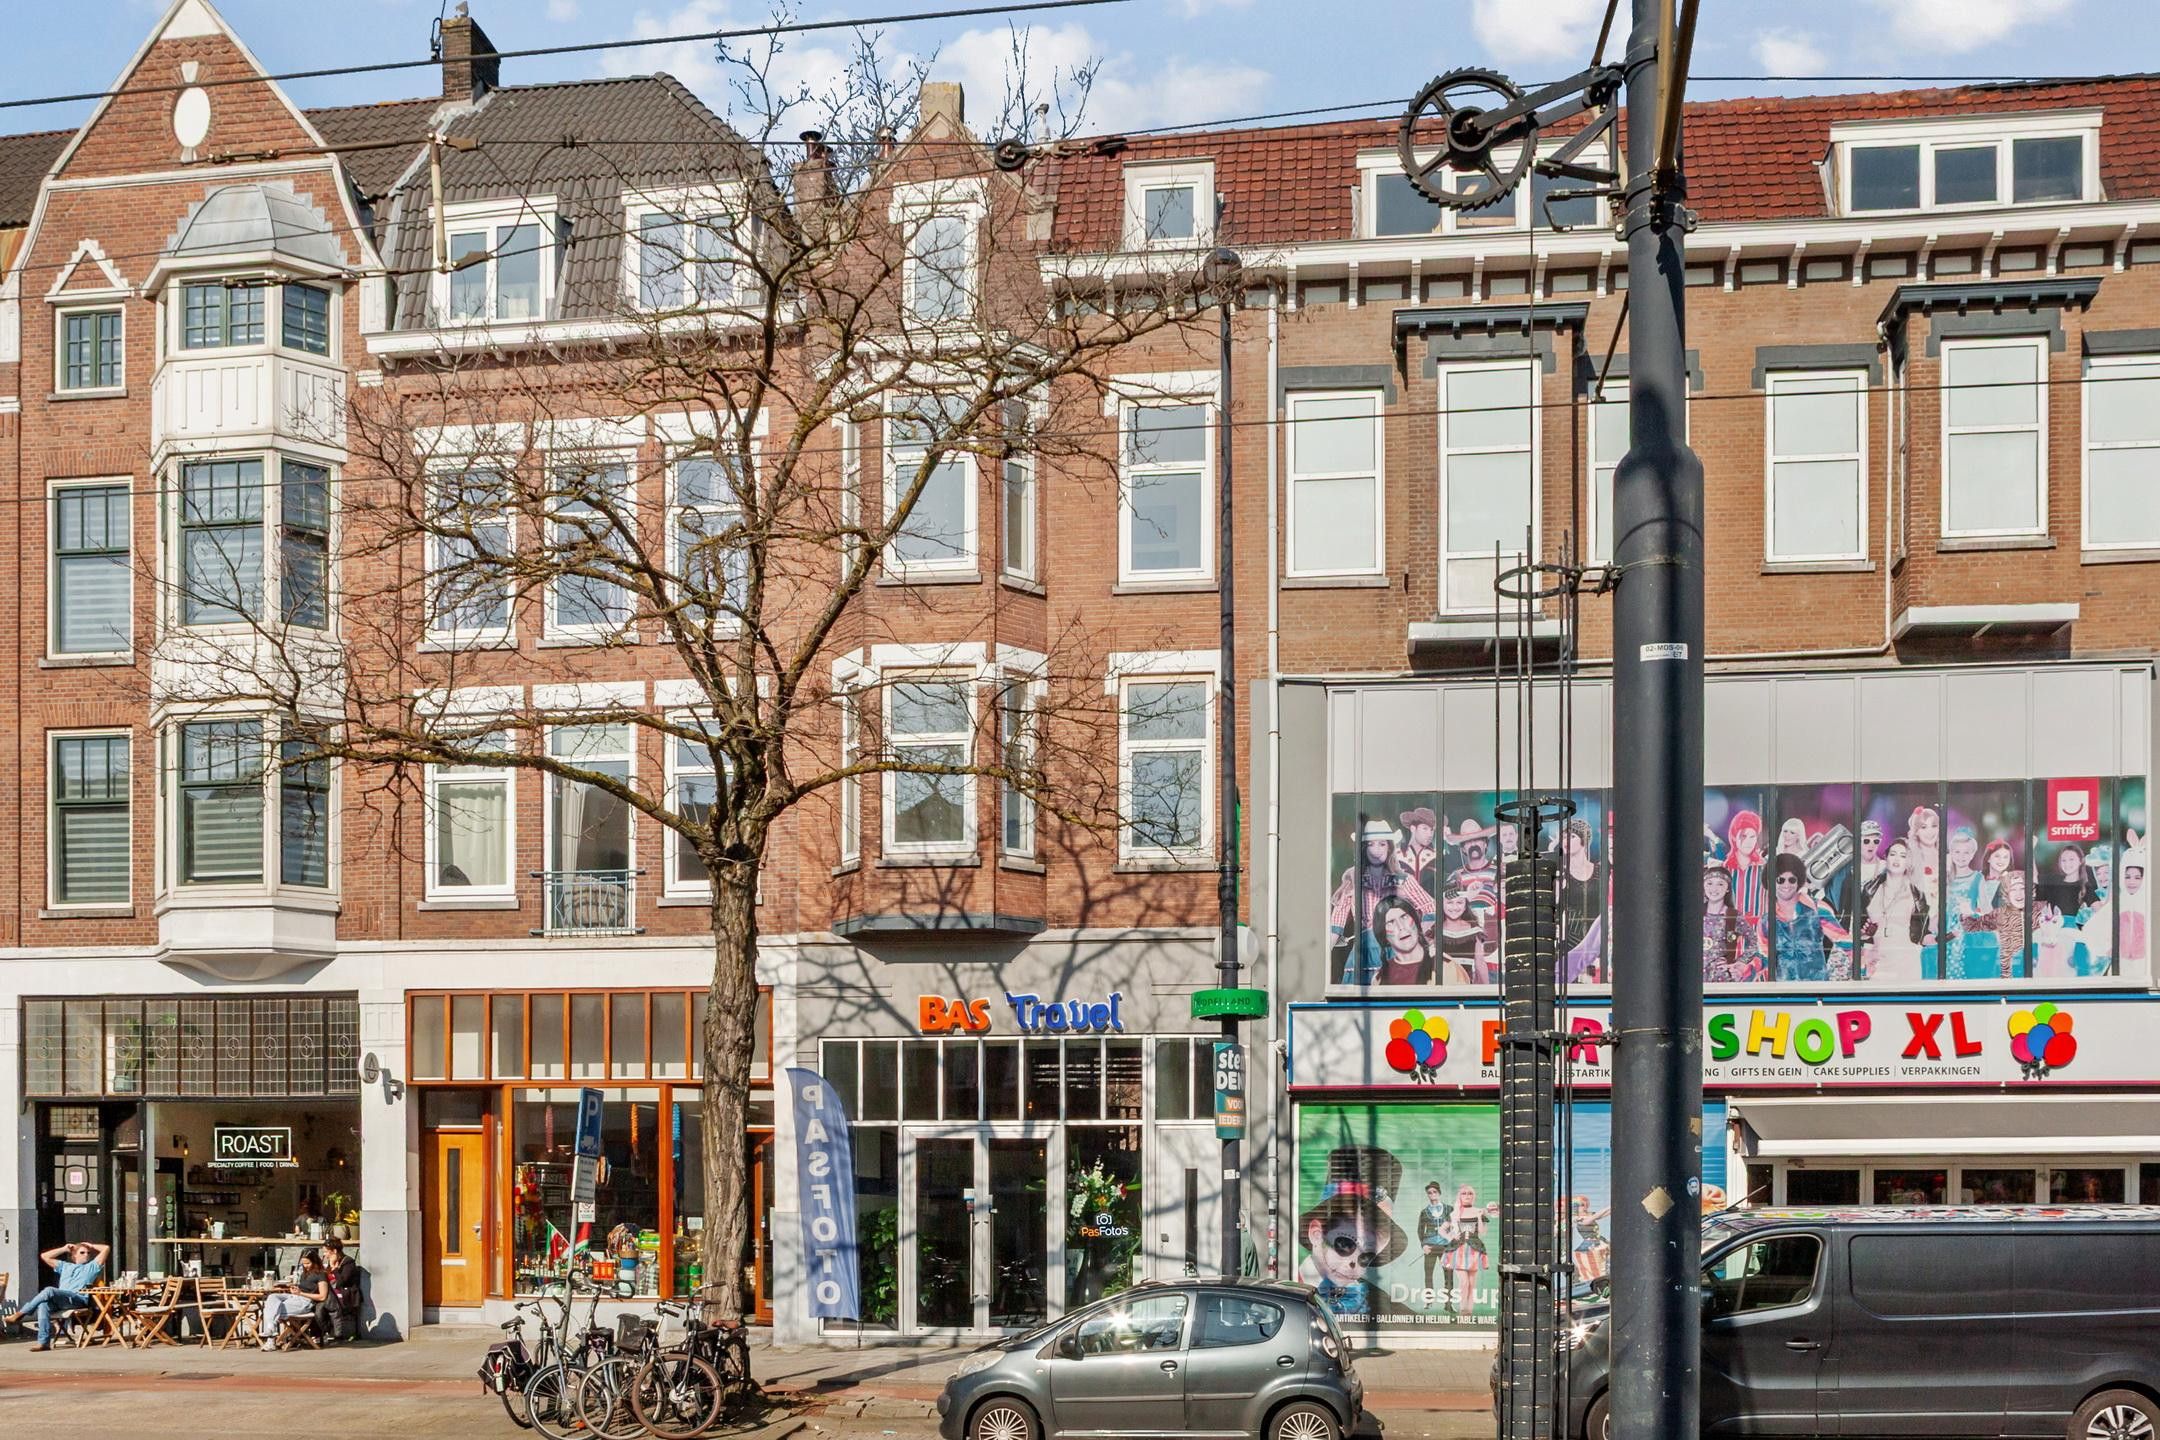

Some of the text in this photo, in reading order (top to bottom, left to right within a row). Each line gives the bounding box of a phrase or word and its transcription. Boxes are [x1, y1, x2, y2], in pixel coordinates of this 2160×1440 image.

[2050, 823, 2095, 838] smiffys
[918, 992, 1124, 1033] BAS Travel
[1708, 1010, 1872, 1066] SHOP
[1901, 1010, 1983, 1061] XL
[1731, 1067, 1760, 1076] GIFTS
[1762, 1067, 1775, 1076] EN
[1778, 1067, 1802, 1076] GEIN
[1813, 1067, 1840, 1076] CAKE
[1842, 1066, 1890, 1076] SUPPLIES
[1901, 1066, 1981, 1075] VERPAKKINGEN
[585, 1094, 599, 1127] P
[221, 1135, 284, 1153] ROAST
[1081, 1226, 1129, 1237] PasFoto's
[1390, 1283, 1462, 1303] Dress
[1333, 1313, 1370, 1323] ARTIKELEN
[1376, 1314, 1414, 1323] BALLONNEN
[1425, 1315, 1450, 1324] HELIUM
[1456, 1315, 1476, 1325] TABLE
[1478, 1315, 1497, 1325] WARE
